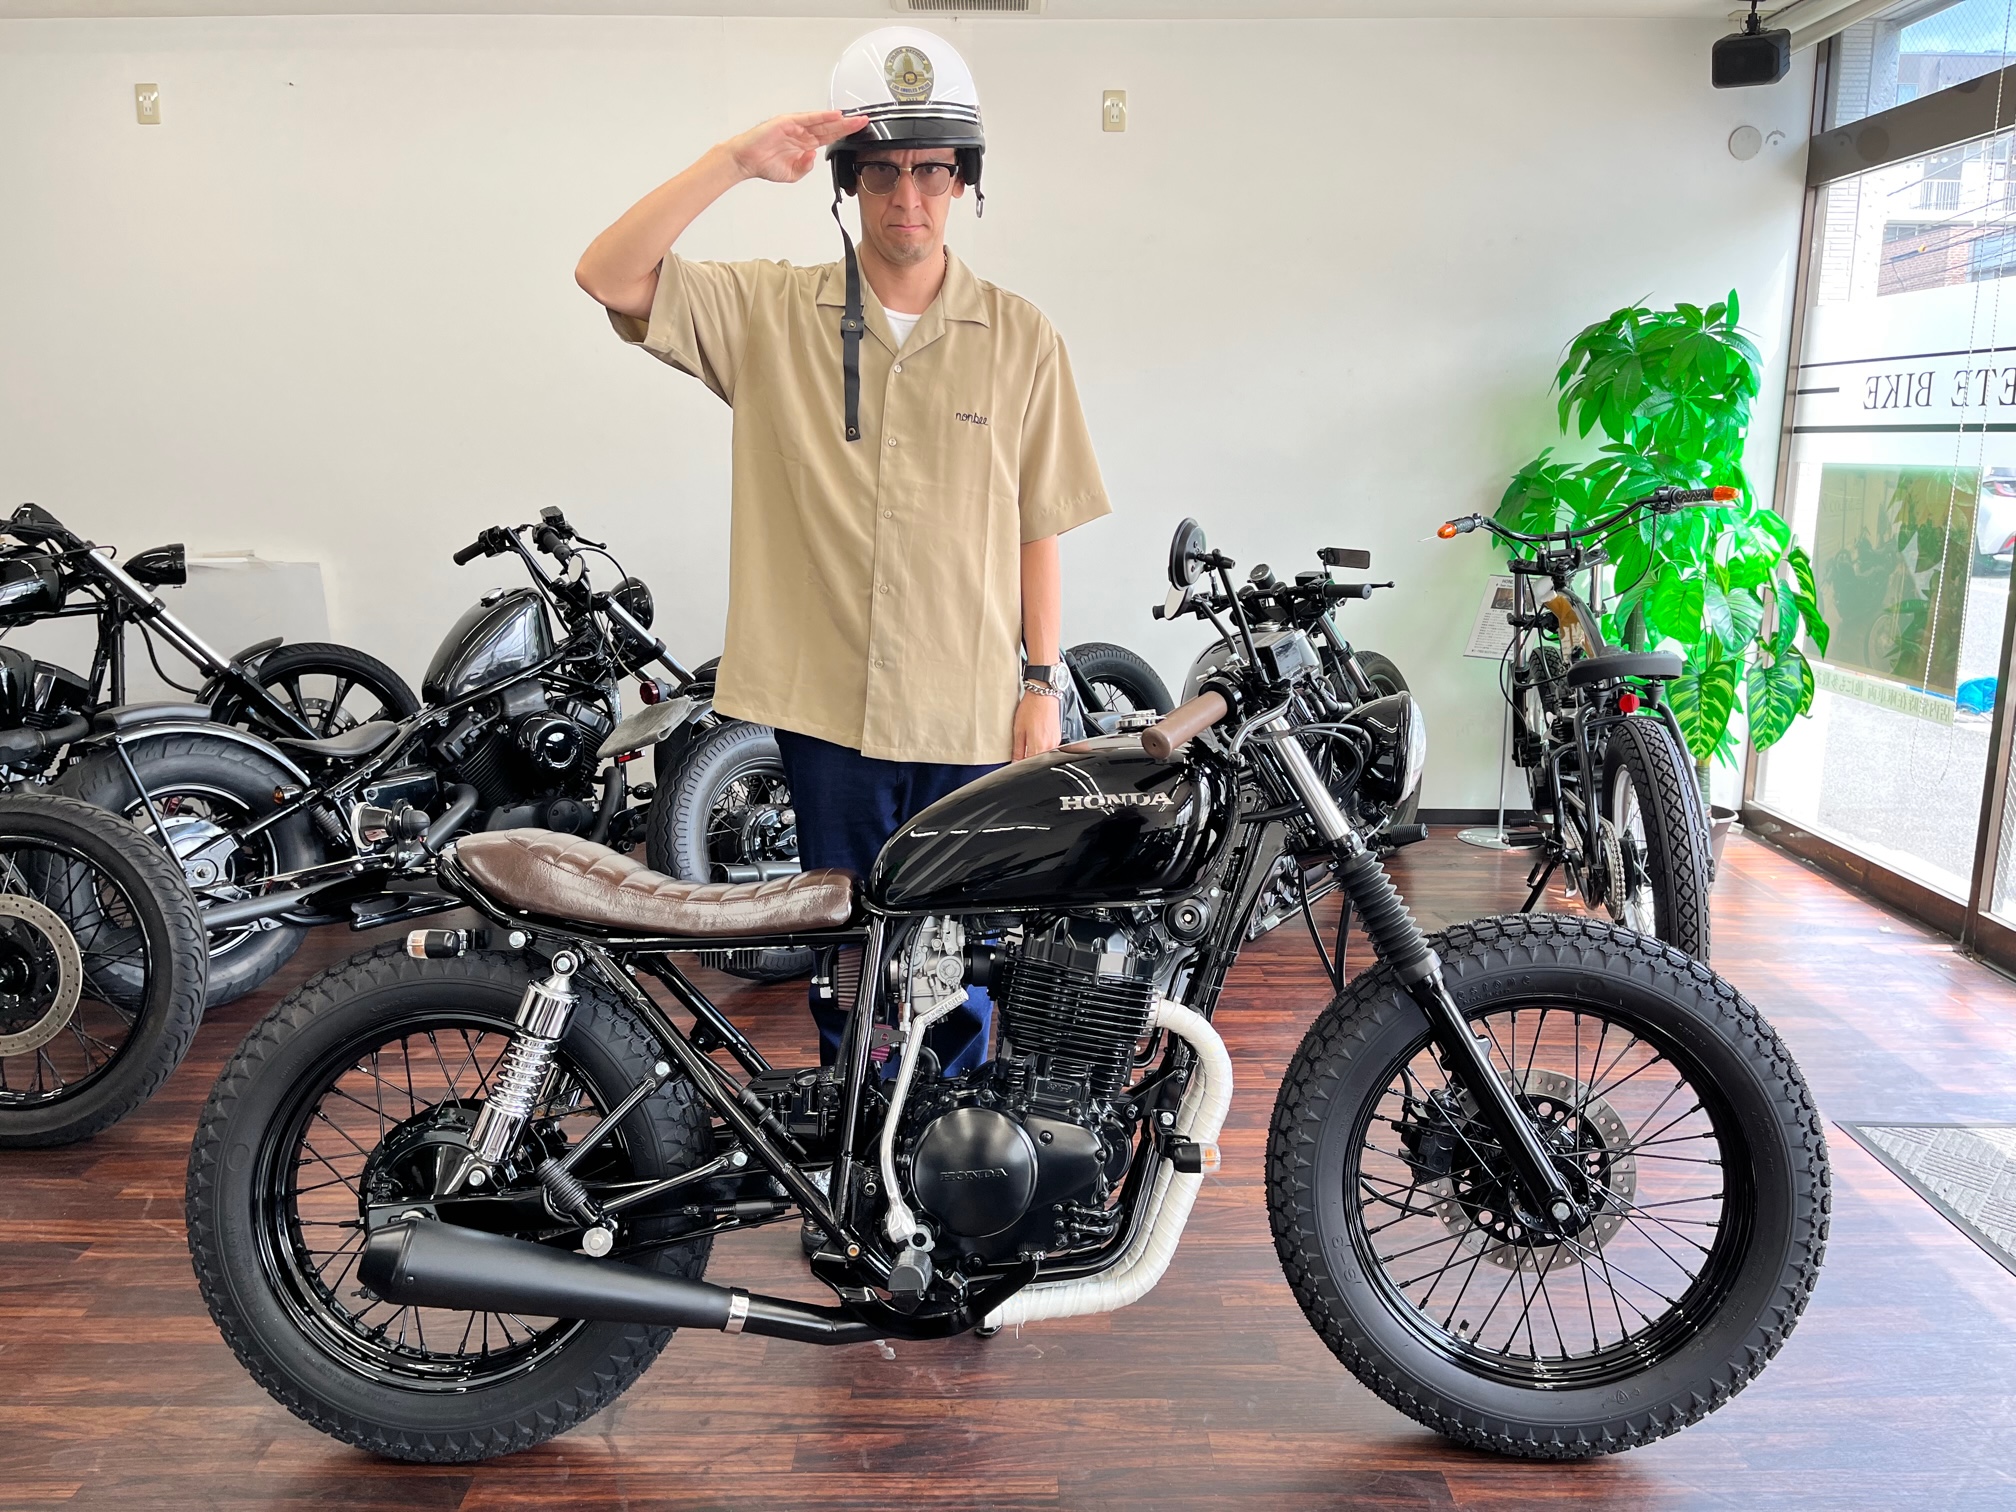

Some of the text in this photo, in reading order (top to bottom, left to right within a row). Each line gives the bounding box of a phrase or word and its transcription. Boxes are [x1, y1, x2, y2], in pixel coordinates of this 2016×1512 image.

[891, 83, 900, 91] LOS
[1059, 791, 1175, 811] HONDA
[939, 1167, 1009, 1182] HONDA
